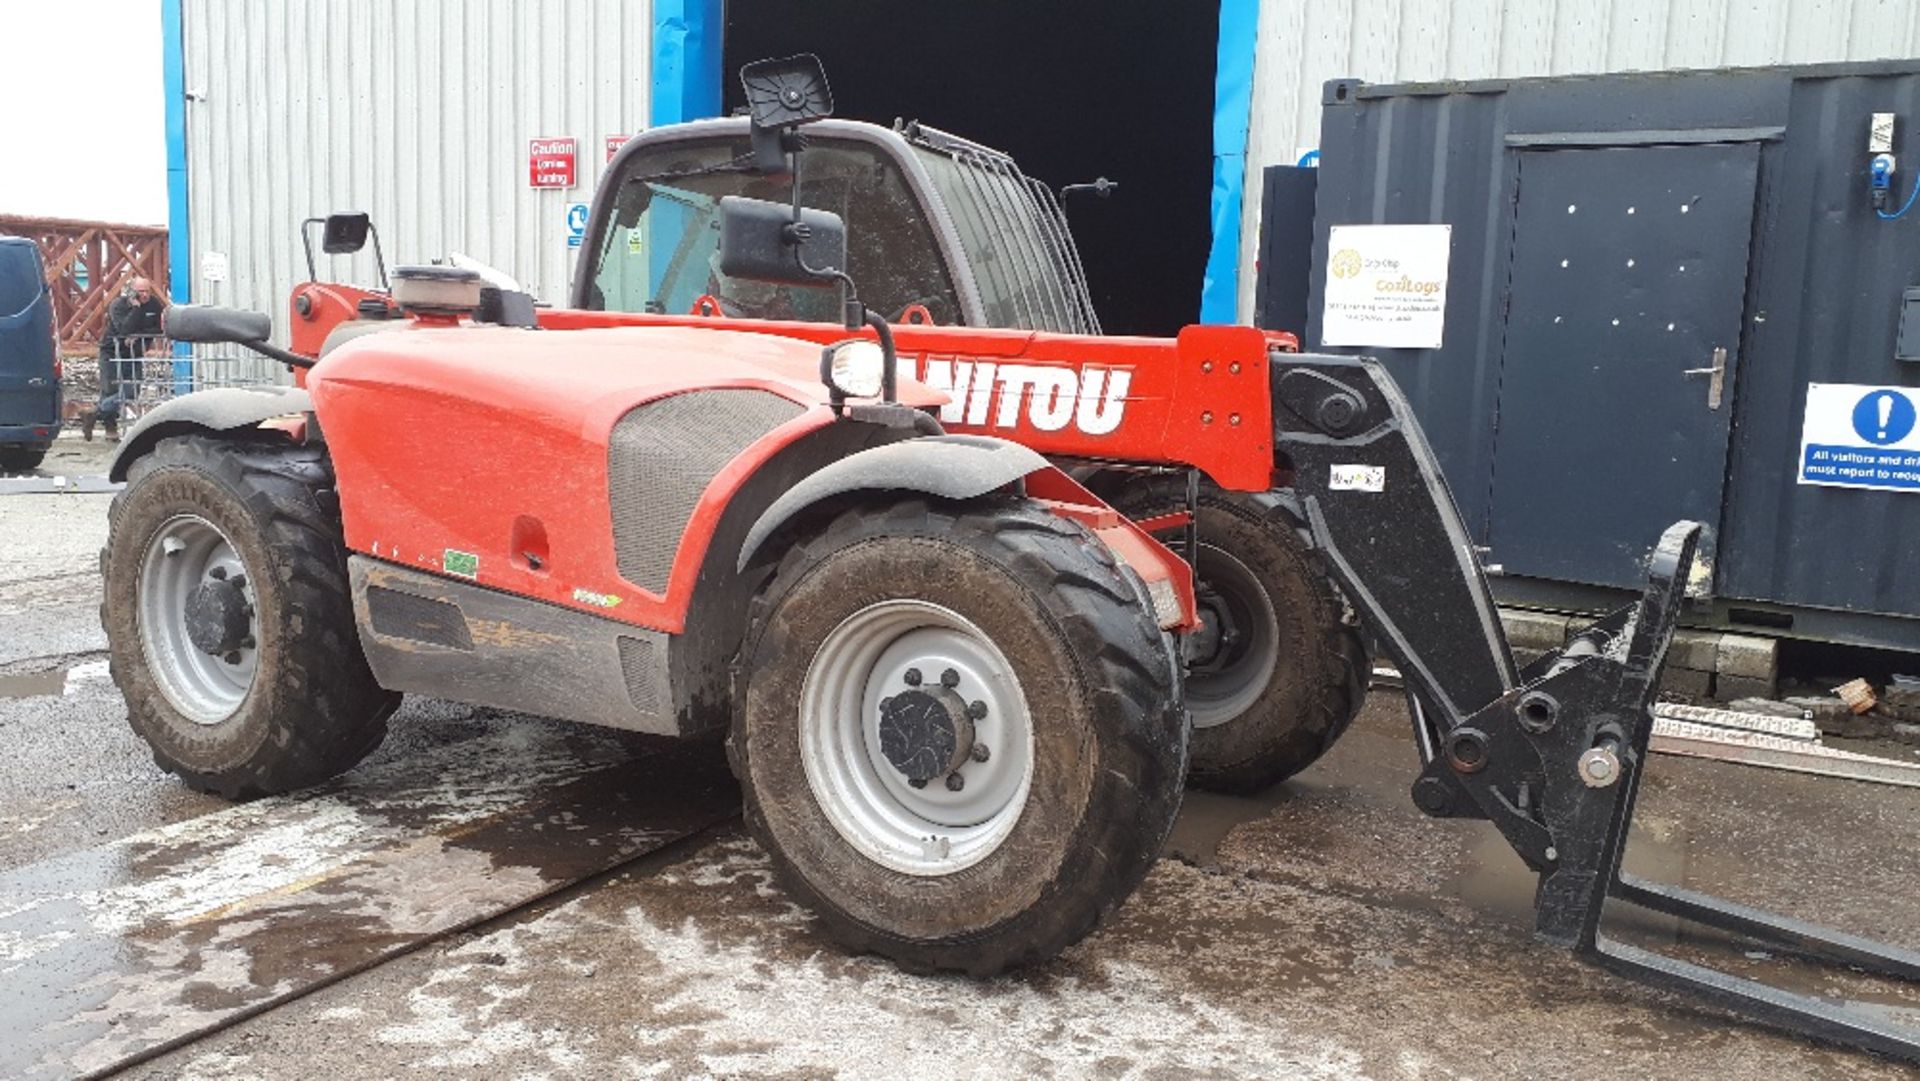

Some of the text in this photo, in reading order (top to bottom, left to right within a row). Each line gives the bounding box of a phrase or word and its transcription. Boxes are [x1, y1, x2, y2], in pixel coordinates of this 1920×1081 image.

[531, 142, 573, 155] Caution
[896, 353, 1134, 436] NITOU
[1812, 450, 1829, 460] All
[1831, 453, 1875, 464] visitors
[1878, 456, 1901, 466] and
[1806, 465, 1836, 475] must
[1839, 467, 1874, 479] report
[1877, 470, 1889, 479] to
